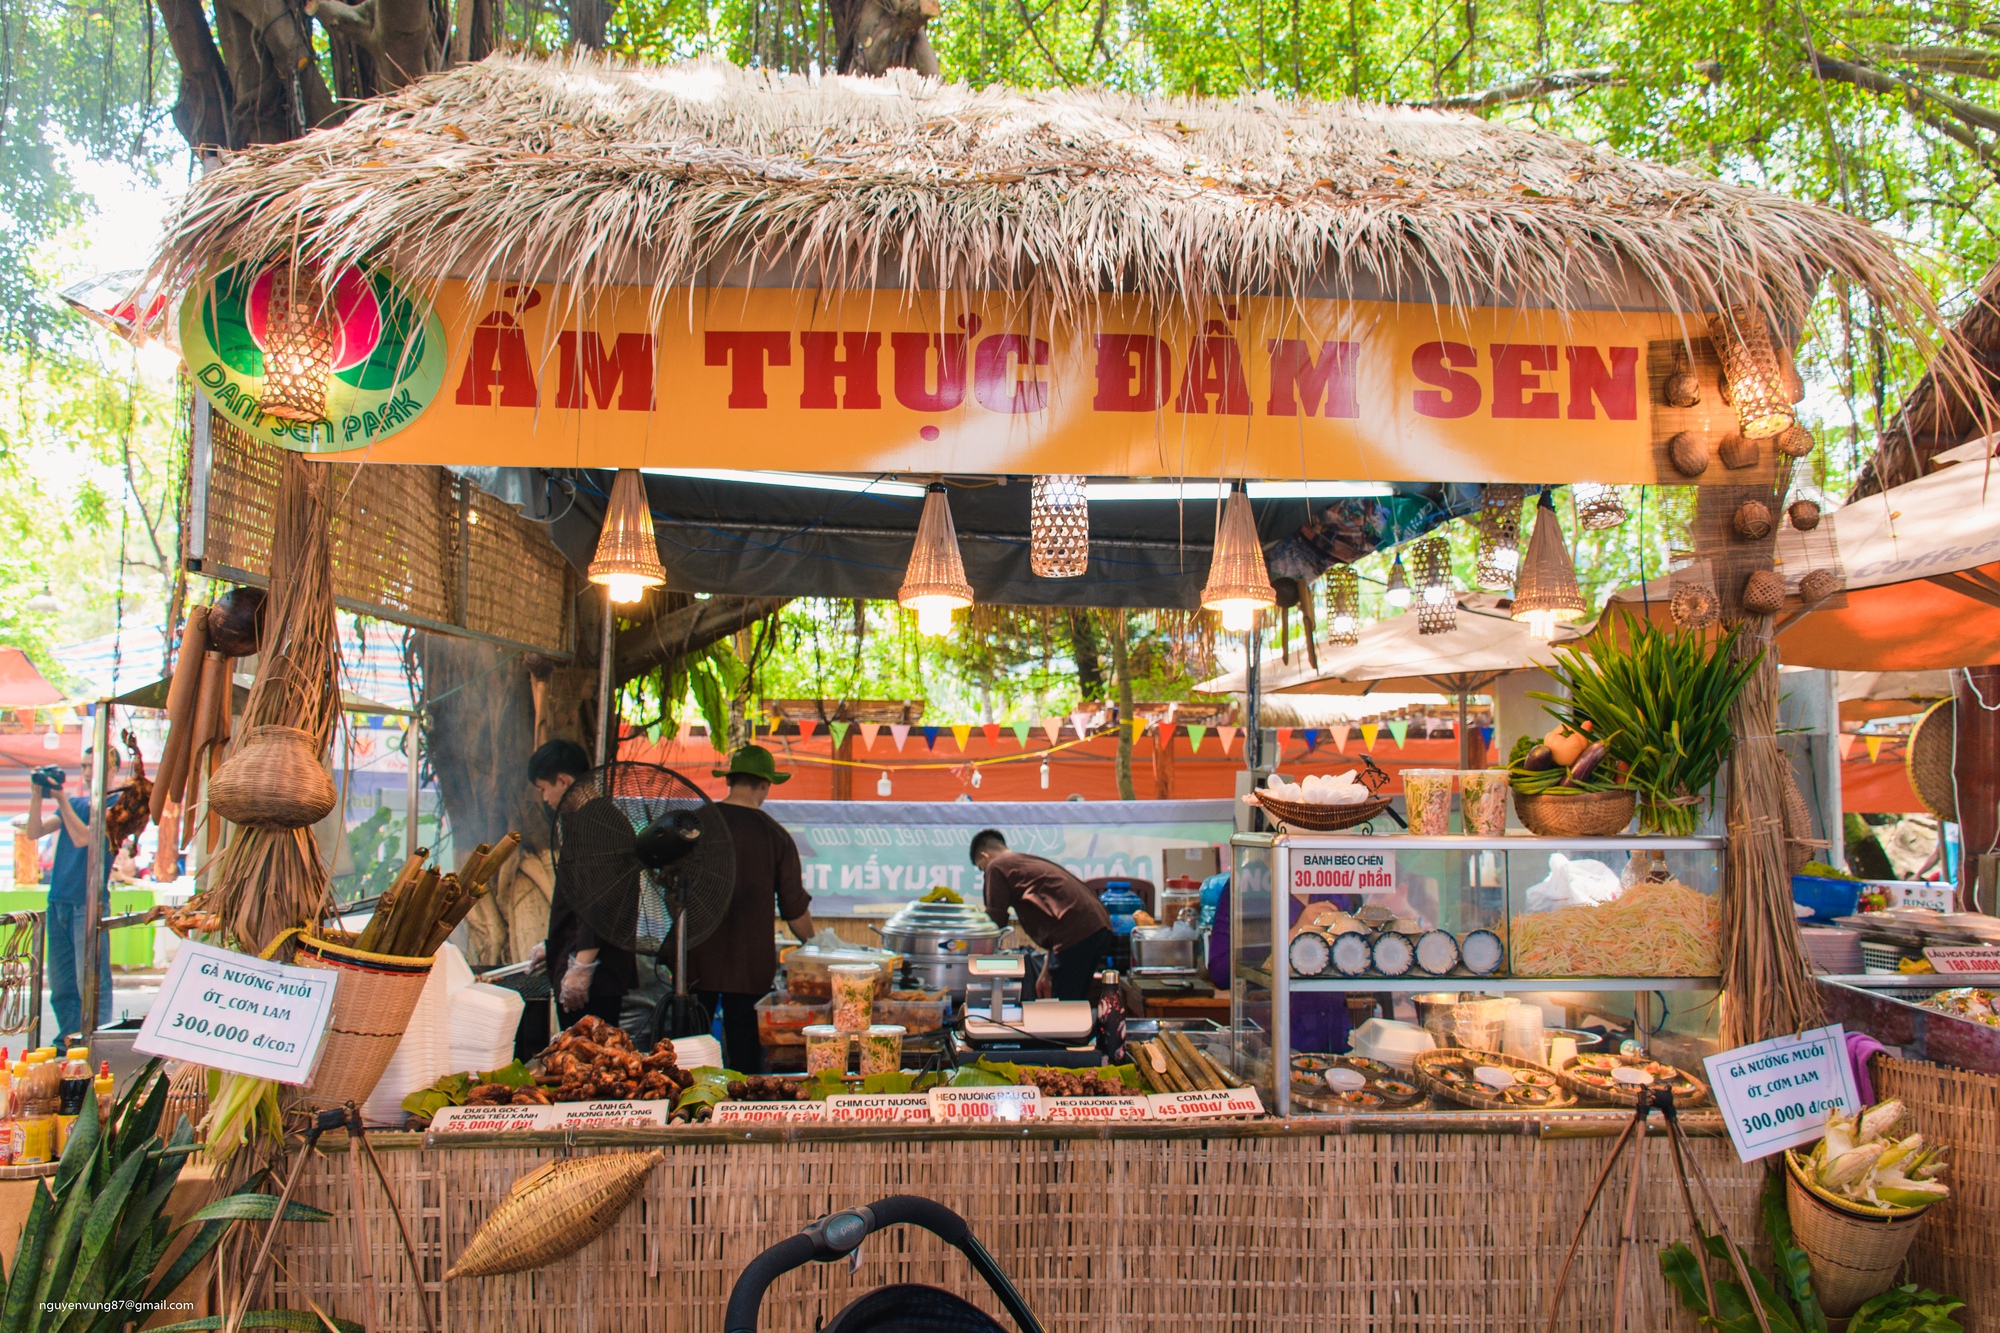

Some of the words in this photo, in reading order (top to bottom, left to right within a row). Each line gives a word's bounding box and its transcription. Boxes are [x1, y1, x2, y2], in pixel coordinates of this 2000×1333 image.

[456, 286, 659, 412] ẨM
[704, 312, 1049, 443] THỰC
[1411, 340, 1639, 421] SEN
[342, 388, 422, 442] PARK
[1852, 540, 2000, 579] Coffee
[1295, 869, 1355, 887] 30.000đ/
[1358, 867, 1392, 889] phần
[200, 962, 220, 979] GÀ
[223, 968, 276, 992] NƯỚNG
[276, 980, 313, 998] MUỐI
[262, 1005, 291, 1021] LAM
[172, 1012, 250, 1043] 300,000
[252, 1033, 296, 1053] đ/con
[1730, 1062, 1747, 1078] GÀ
[1747, 1053, 1790, 1073] NƯỚNG
[1792, 1042, 1826, 1062] MUỐI
[1794, 1070, 1820, 1085] LAM
[935, 1093, 957, 1102] HEO
[1158, 1101, 1222, 1116] 45.000đ/
[1204, 1092, 1230, 1101] LAM
[1742, 1102, 1806, 1134] 300,000
[1808, 1096, 1845, 1115] đ/con
